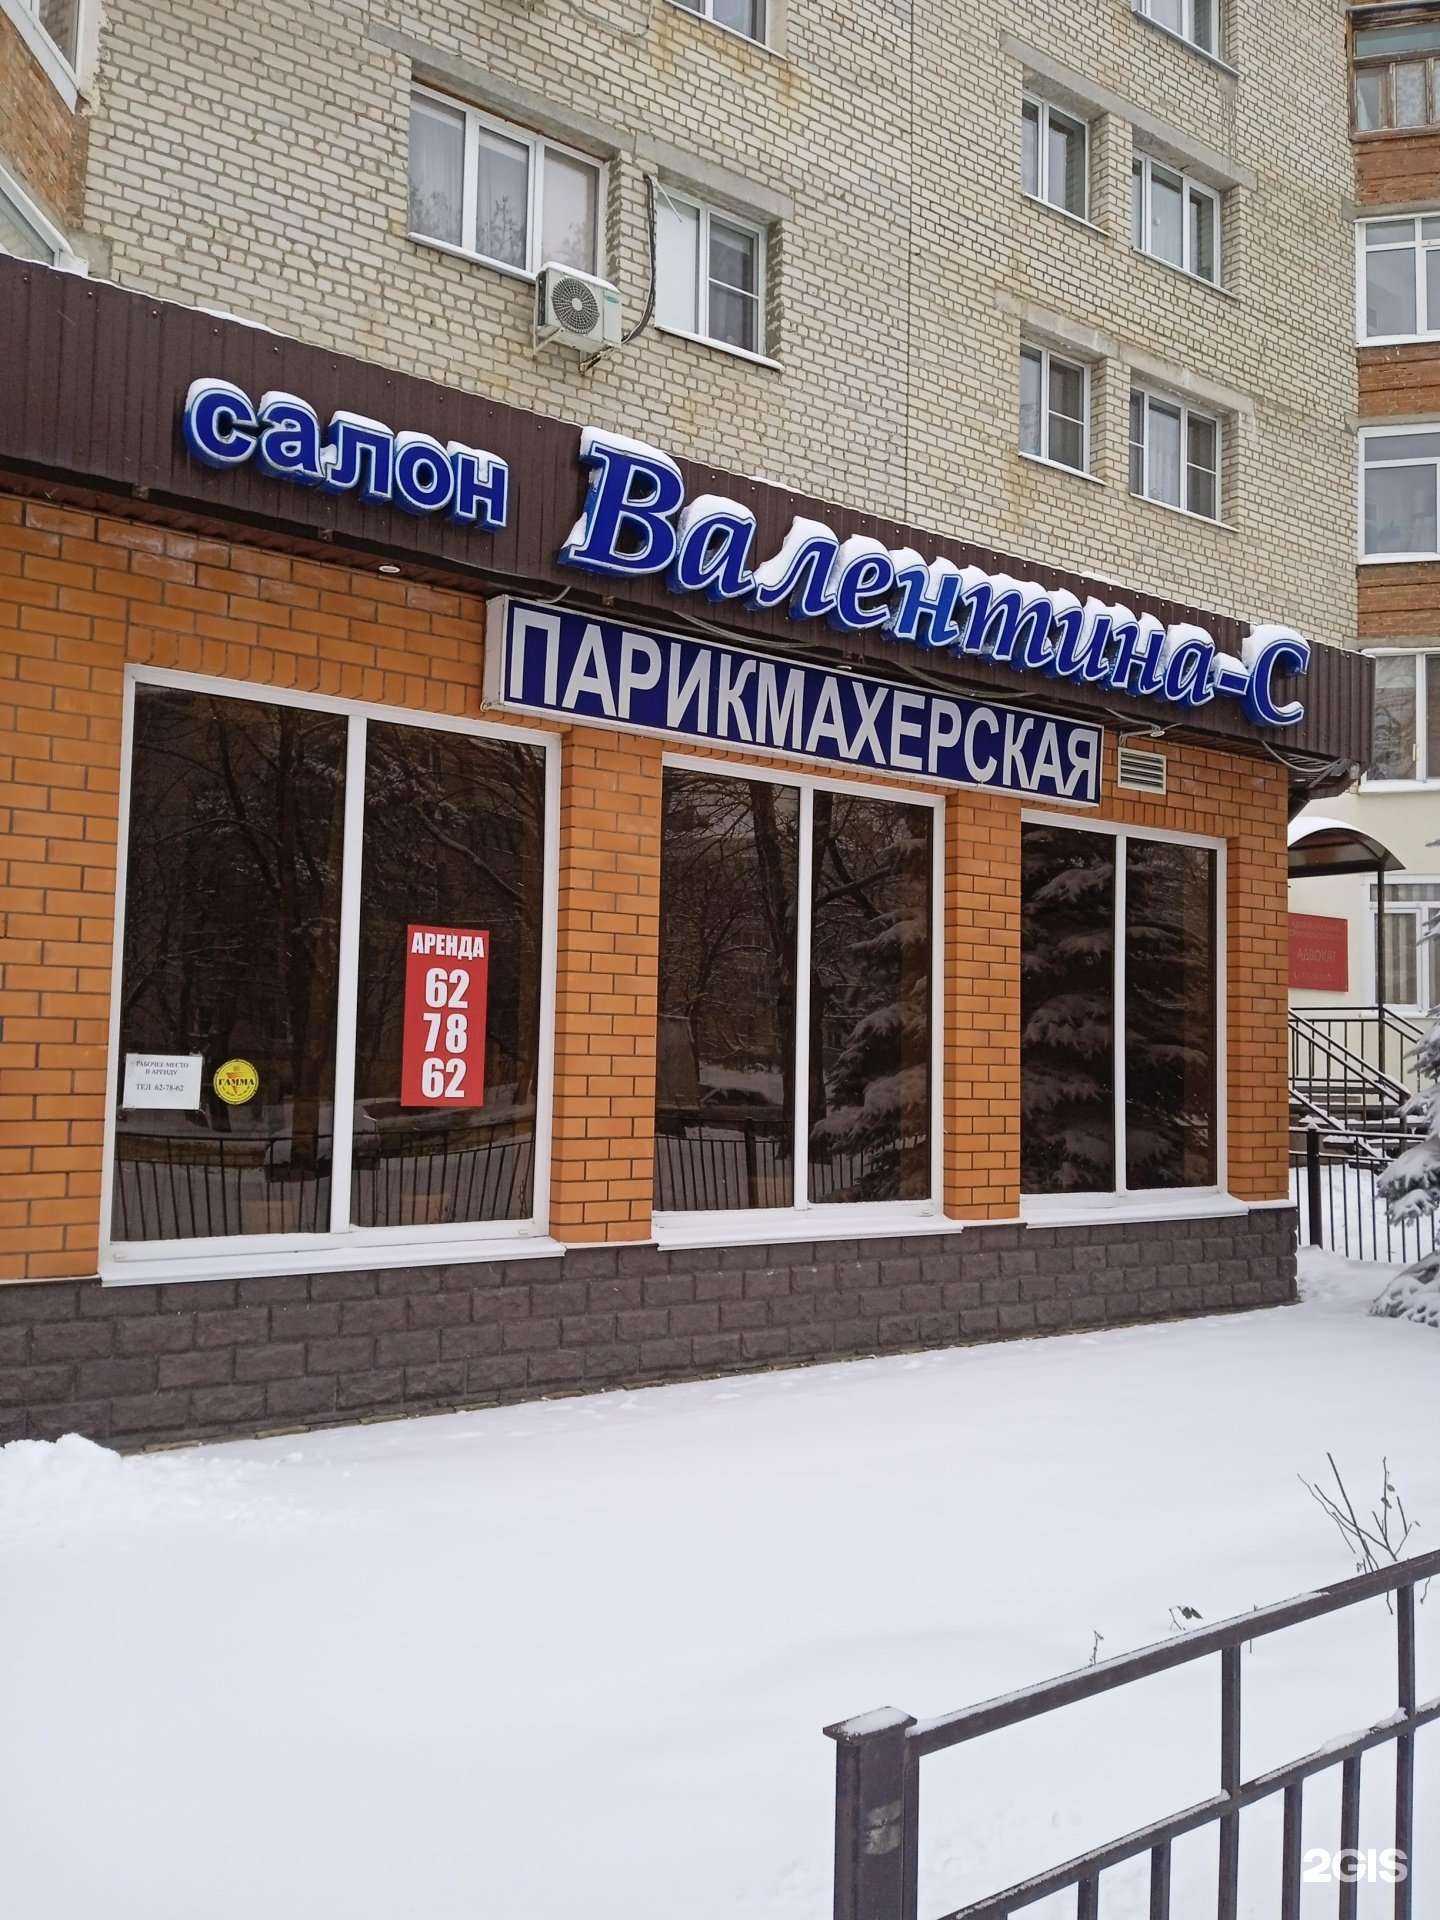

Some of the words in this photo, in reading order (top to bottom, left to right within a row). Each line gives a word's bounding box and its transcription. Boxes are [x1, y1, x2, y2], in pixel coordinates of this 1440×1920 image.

[185, 382, 509, 529] салон
[563, 436, 1309, 728] Валентина-С
[508, 607, 1098, 800] ПАРИКМАХЕРСКАЯ
[411, 932, 485, 960] АРЕНДА
[425, 967, 470, 1009] 62
[423, 1012, 468, 1053] 78
[217, 1078, 255, 1086] ГАММА
[421, 1057, 467, 1098] 62
